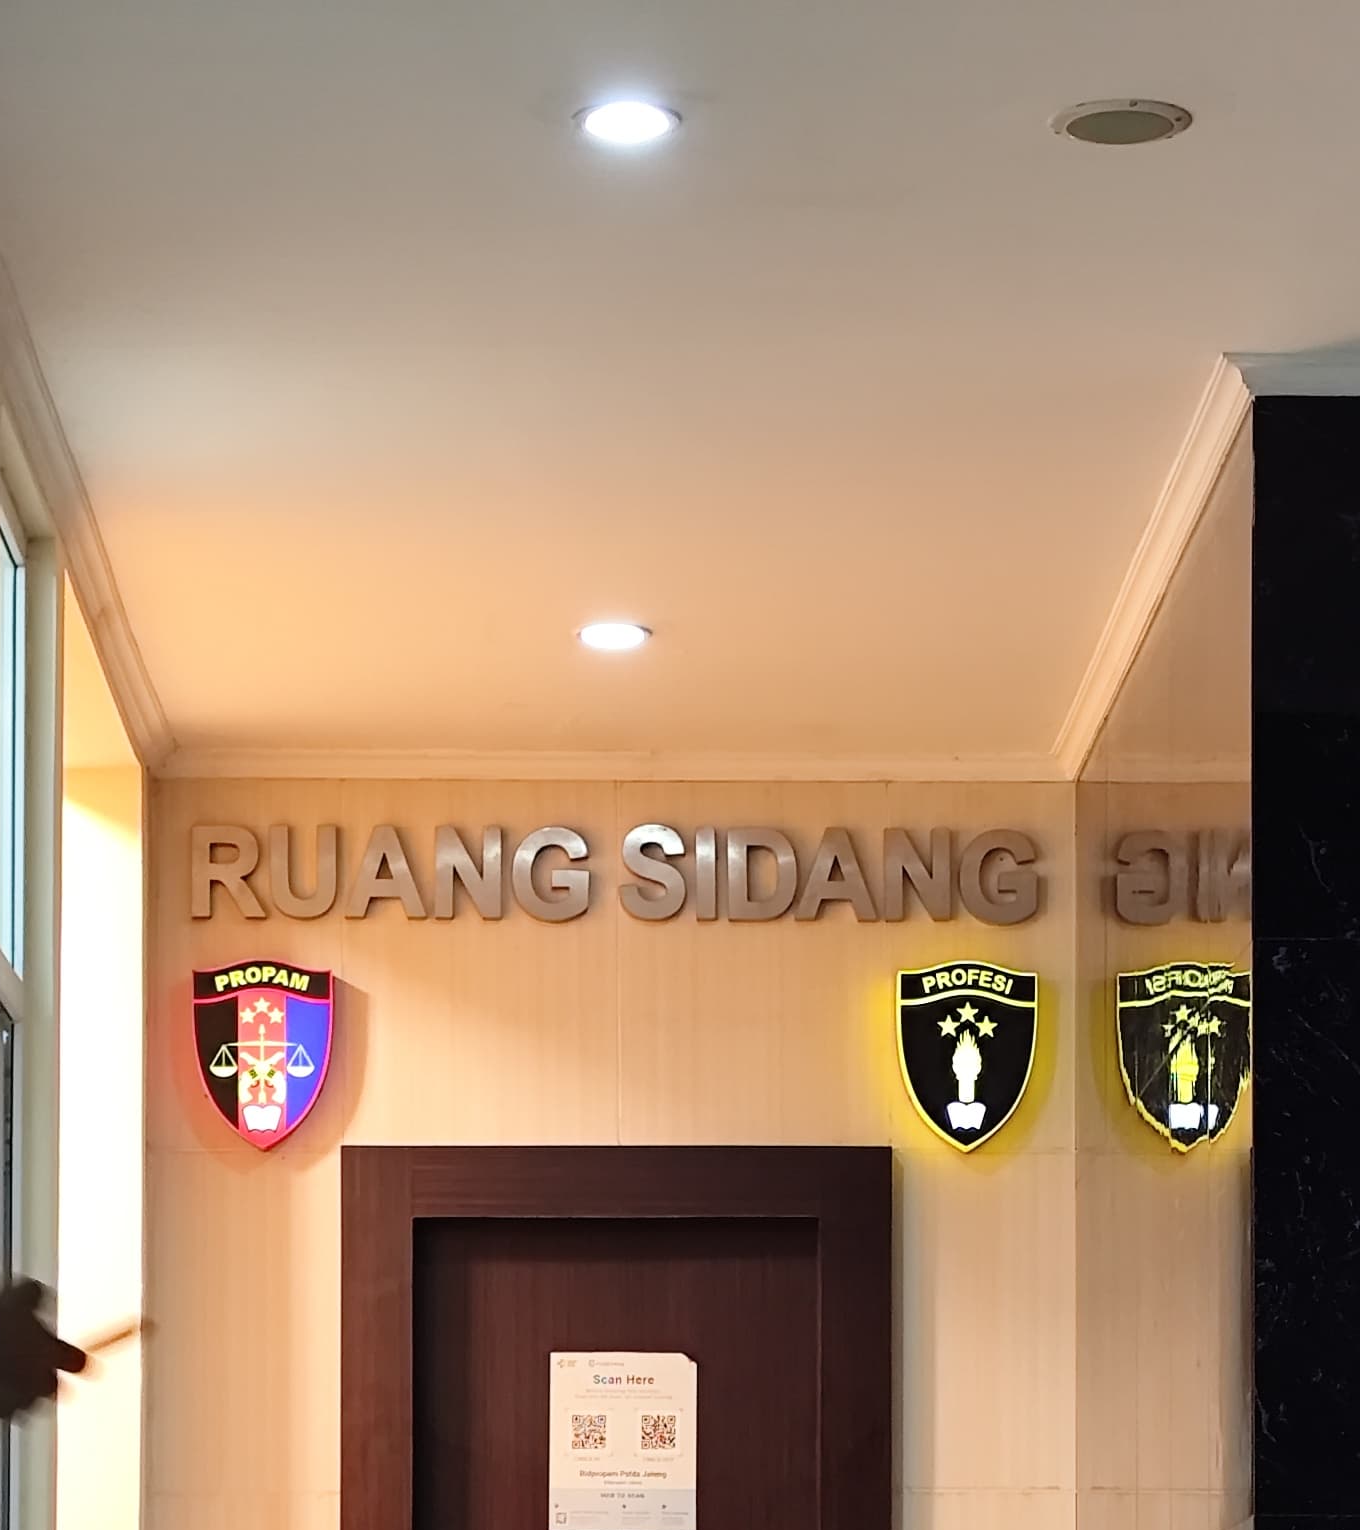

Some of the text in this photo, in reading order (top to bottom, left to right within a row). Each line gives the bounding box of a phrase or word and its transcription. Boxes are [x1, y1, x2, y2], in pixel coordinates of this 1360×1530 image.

[190, 823, 590, 923] RUANG
[618, 823, 1040, 927] SIDANG
[214, 966, 310, 992] PROPAM
[921, 968, 1014, 995] PROFESI
[593, 1374, 655, 1385] Scan Here
